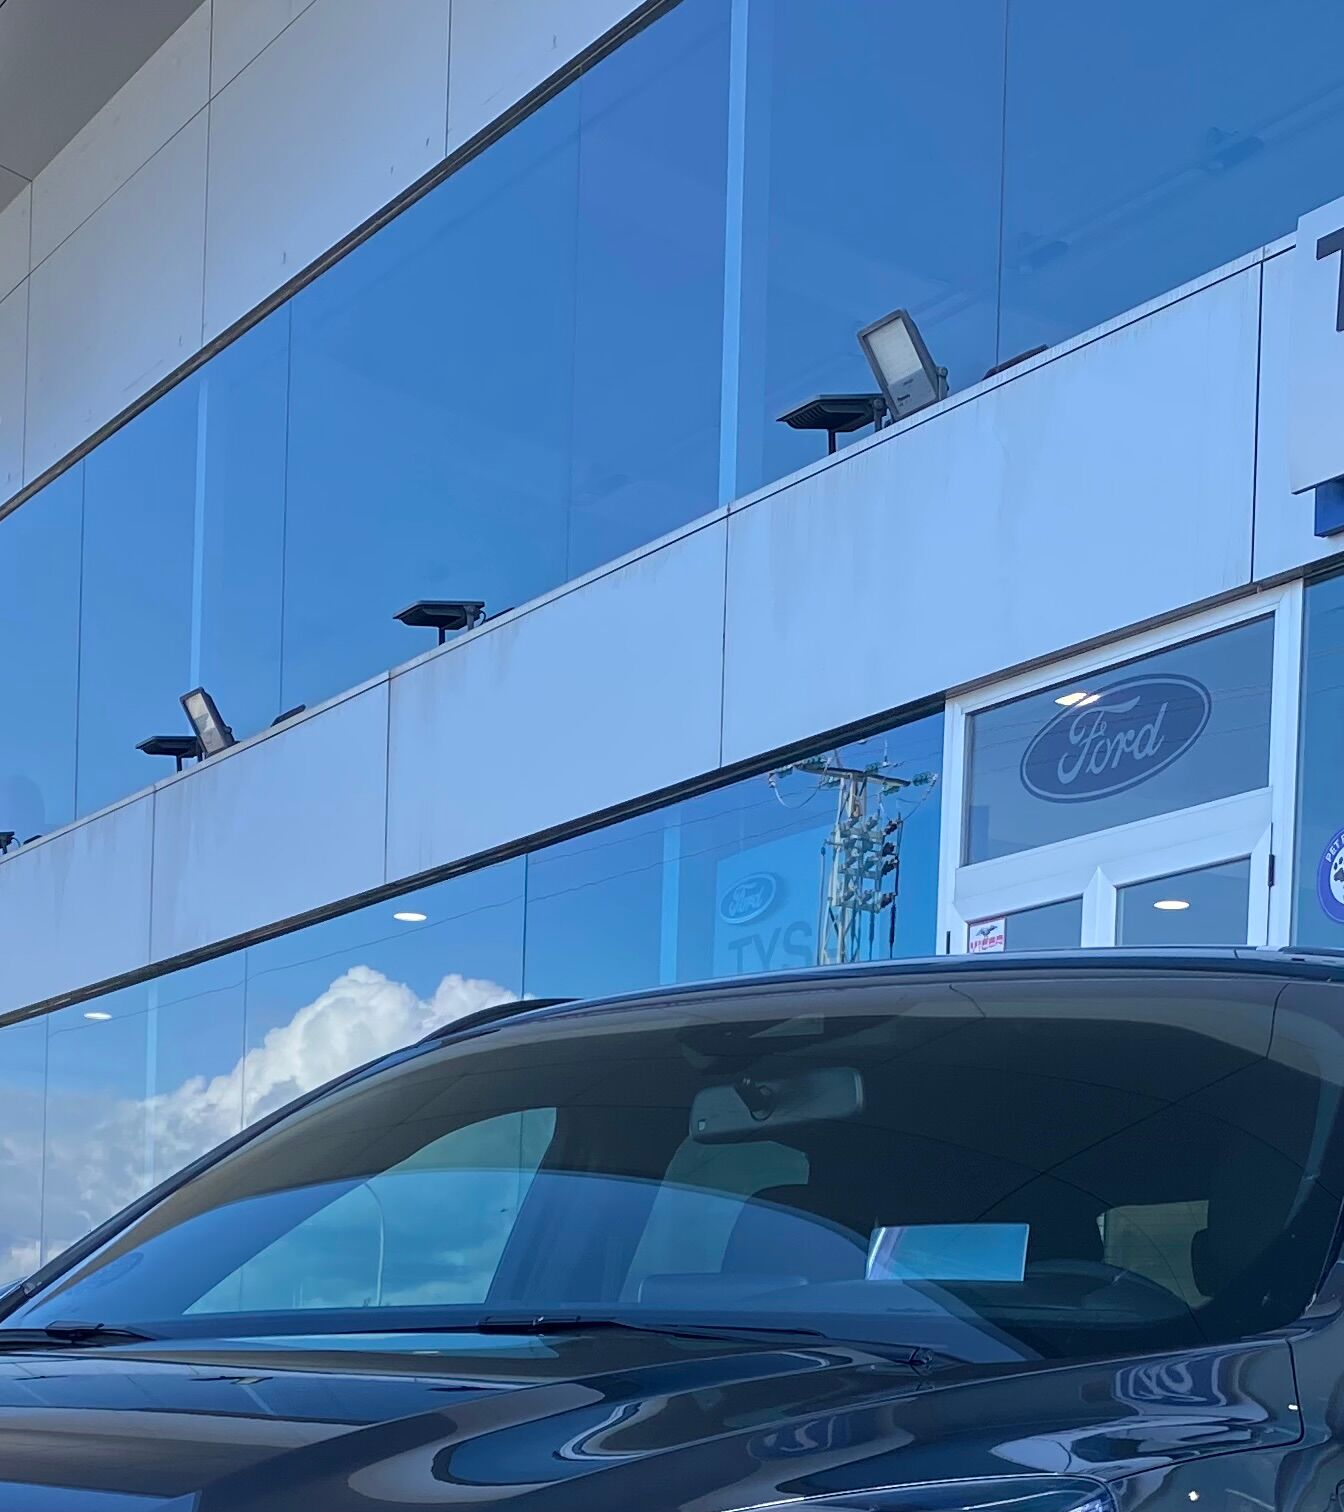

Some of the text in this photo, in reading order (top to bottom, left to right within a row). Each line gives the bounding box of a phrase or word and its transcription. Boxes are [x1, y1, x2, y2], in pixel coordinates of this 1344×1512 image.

[1058, 696, 1169, 784] Ford
[1325, 838, 1340, 863] PET
[728, 921, 834, 974] TYS
